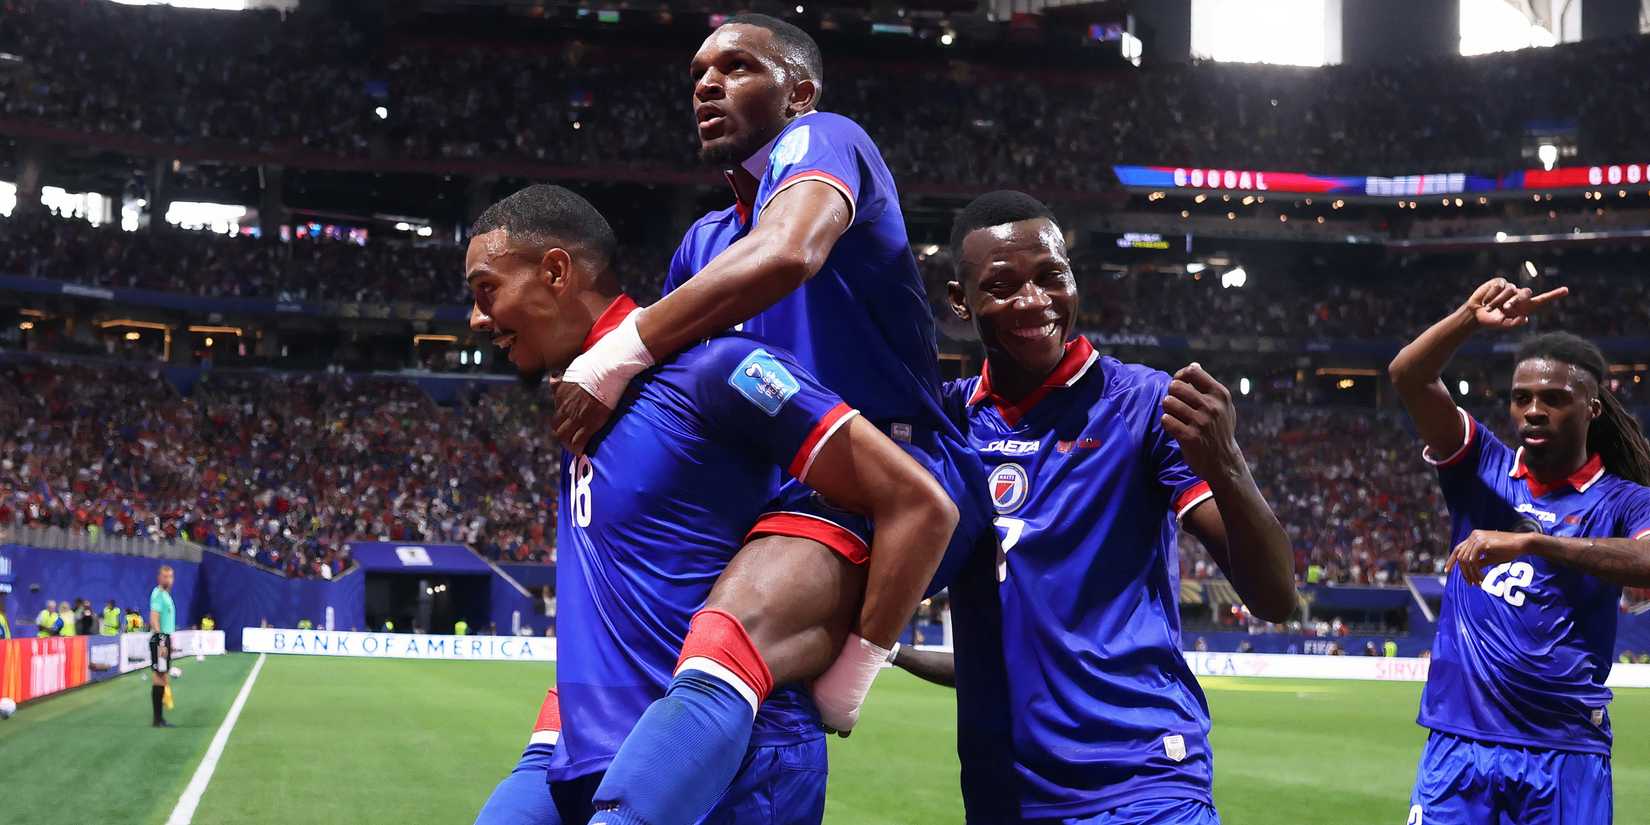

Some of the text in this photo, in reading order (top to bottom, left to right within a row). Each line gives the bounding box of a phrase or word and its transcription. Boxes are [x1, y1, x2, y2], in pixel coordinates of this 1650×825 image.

[1589, 164, 1650, 186] GOO
[1088, 332, 1159, 346] TLANTA
[980, 440, 1040, 454] SAETA
[569, 454, 594, 528] 18
[1481, 562, 1534, 607] 22
[273, 633, 534, 658] BANK OF AMERICA
